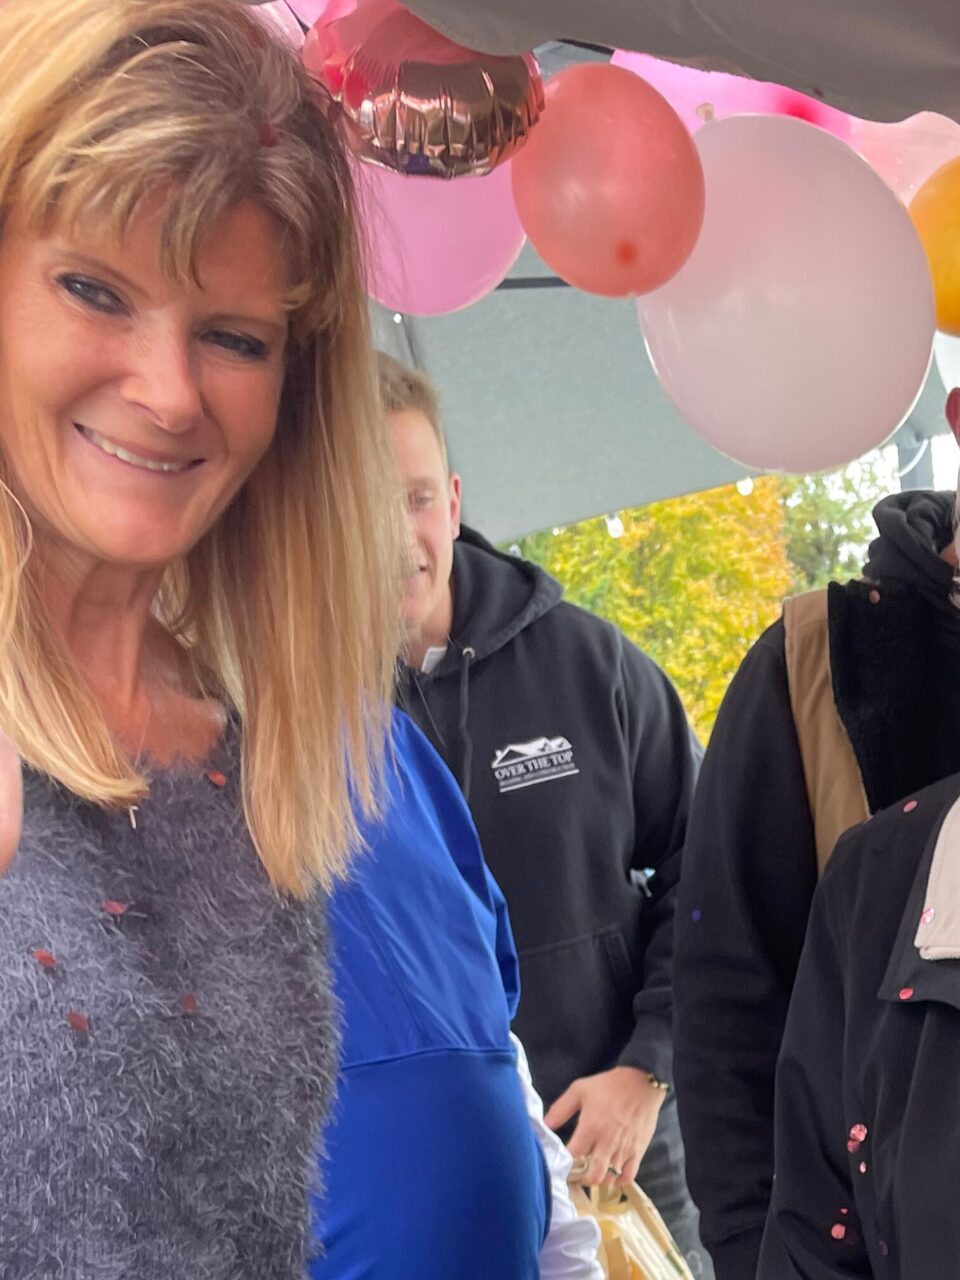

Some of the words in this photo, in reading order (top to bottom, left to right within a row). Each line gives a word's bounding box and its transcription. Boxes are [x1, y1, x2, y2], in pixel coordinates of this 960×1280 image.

[495, 763, 526, 780] OVER
[524, 756, 551, 772] THE
[550, 750, 573, 766] TOP
